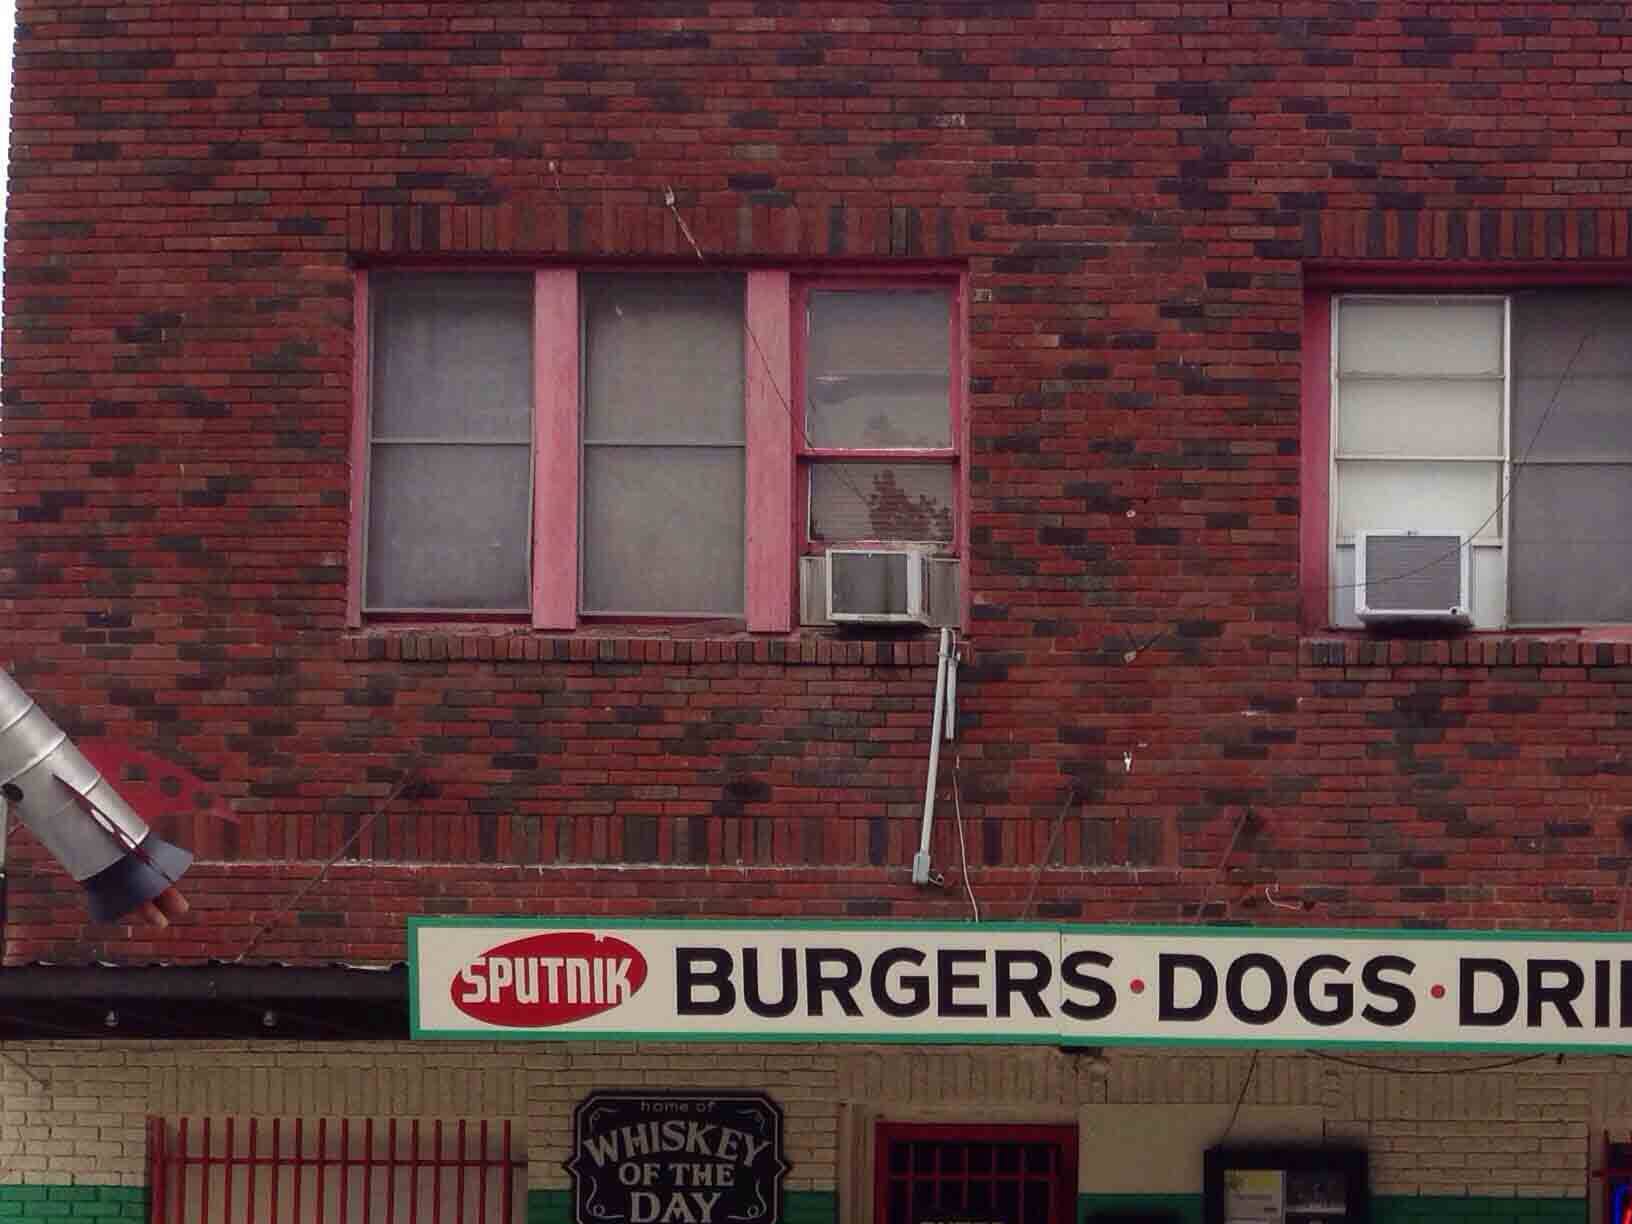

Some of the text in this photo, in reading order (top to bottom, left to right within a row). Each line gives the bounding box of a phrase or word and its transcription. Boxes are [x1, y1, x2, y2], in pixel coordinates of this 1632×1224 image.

[460, 956, 634, 1005] SPUTNIK
[675, 946, 1117, 1018] BURGERS
[1158, 953, 1416, 1027] DOGS
[641, 1100, 716, 1112] home of
[583, 1120, 772, 1168] WHISKEY
[618, 1162, 735, 1187] OF THE
[629, 1191, 722, 1224] DAY
